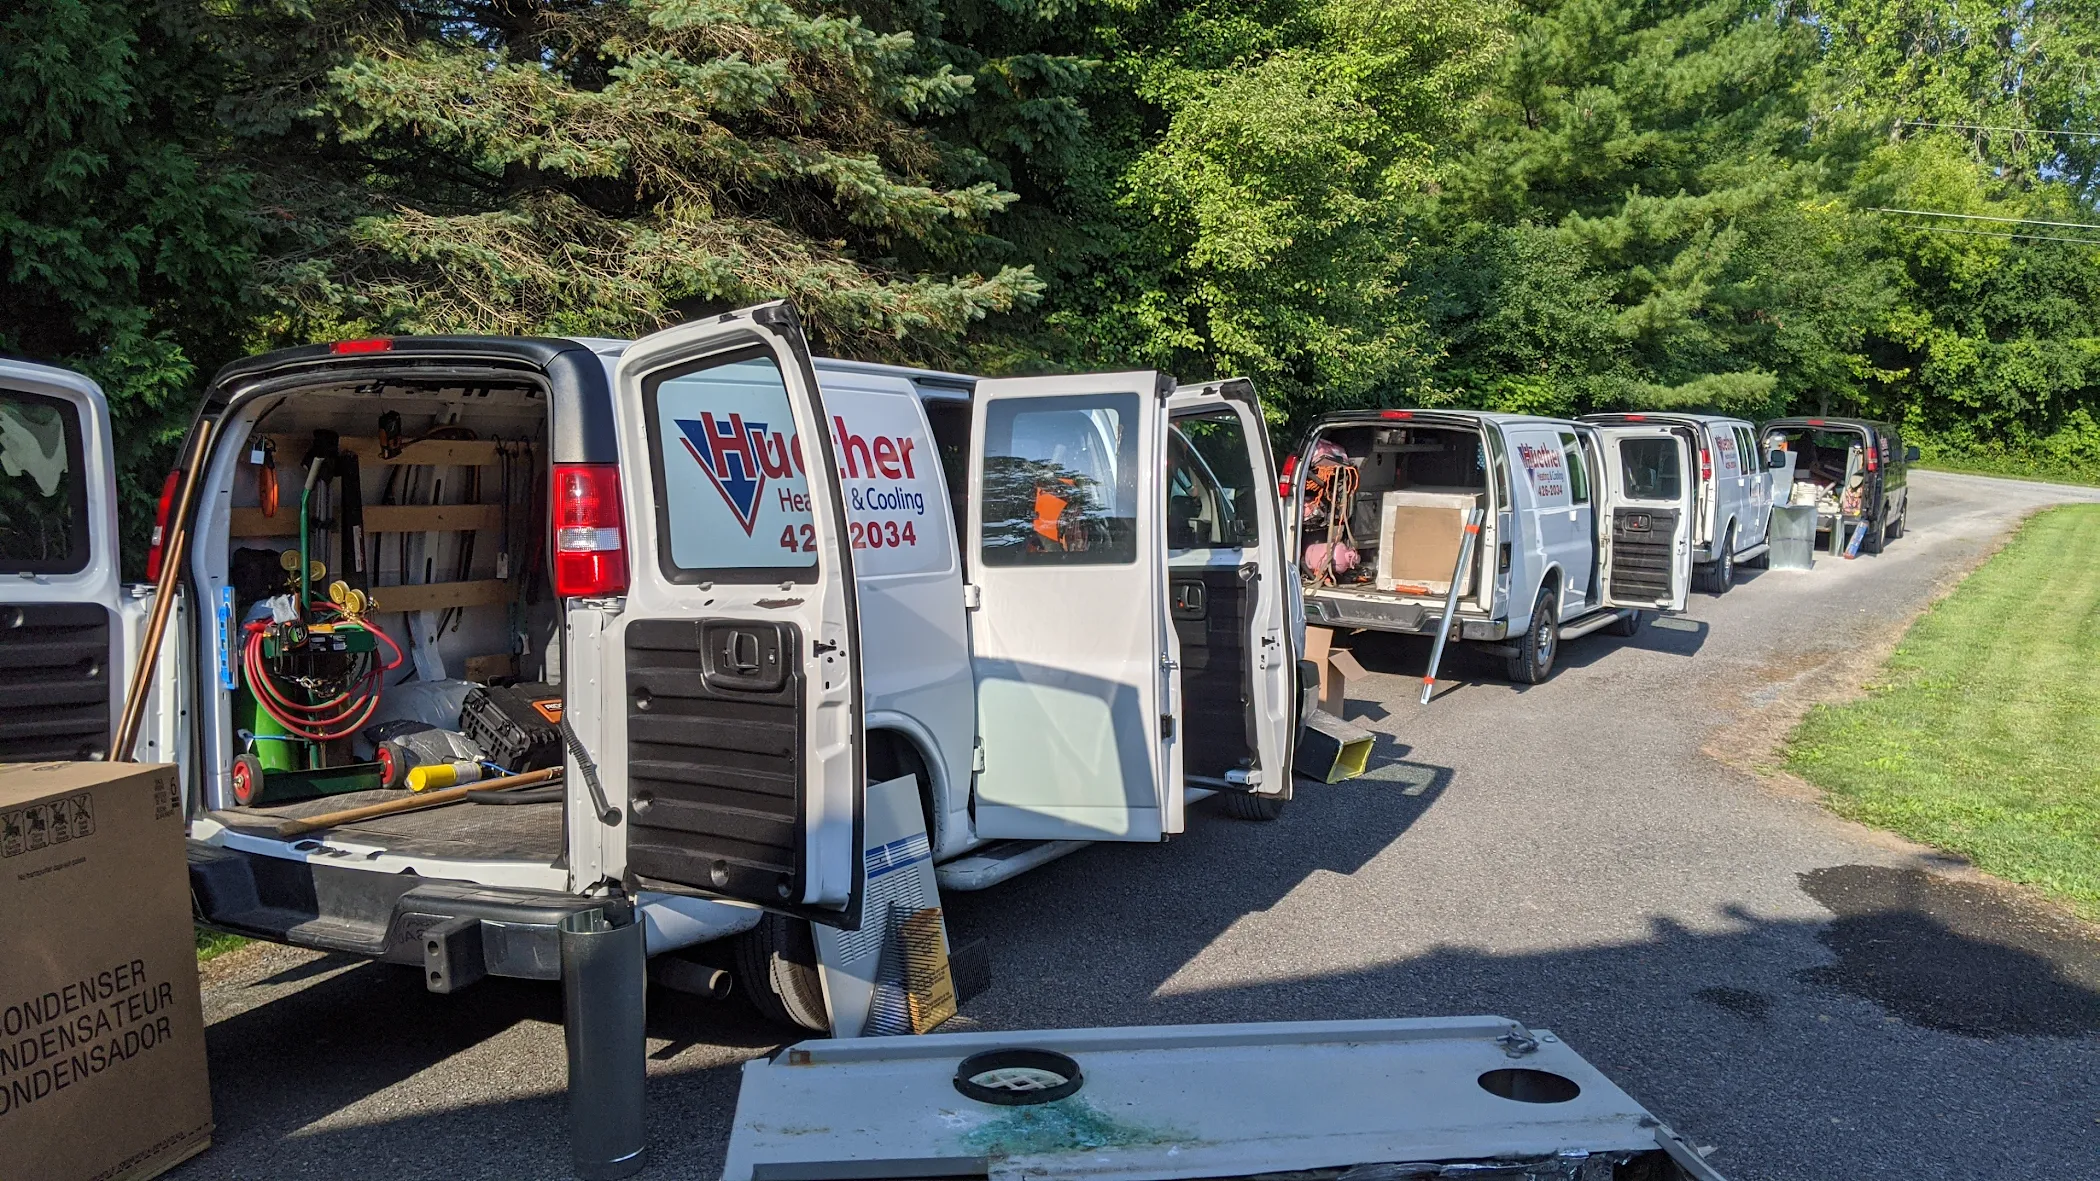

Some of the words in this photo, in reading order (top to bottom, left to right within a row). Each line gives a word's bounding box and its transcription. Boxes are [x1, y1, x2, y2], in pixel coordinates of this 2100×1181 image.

[700, 411, 915, 479] Huher
[1520, 442, 1561, 468] Huether
[852, 487, 865, 511] &
[866, 486, 924, 516] Cooling
[1538, 484, 1563, 496] 426-2034
[780, 520, 916, 553] 422034
[0, 958, 146, 1037] ONDENSER
[0, 981, 173, 1076] NDENSATEUR
[0, 1016, 171, 1116] ONDENSADOR
